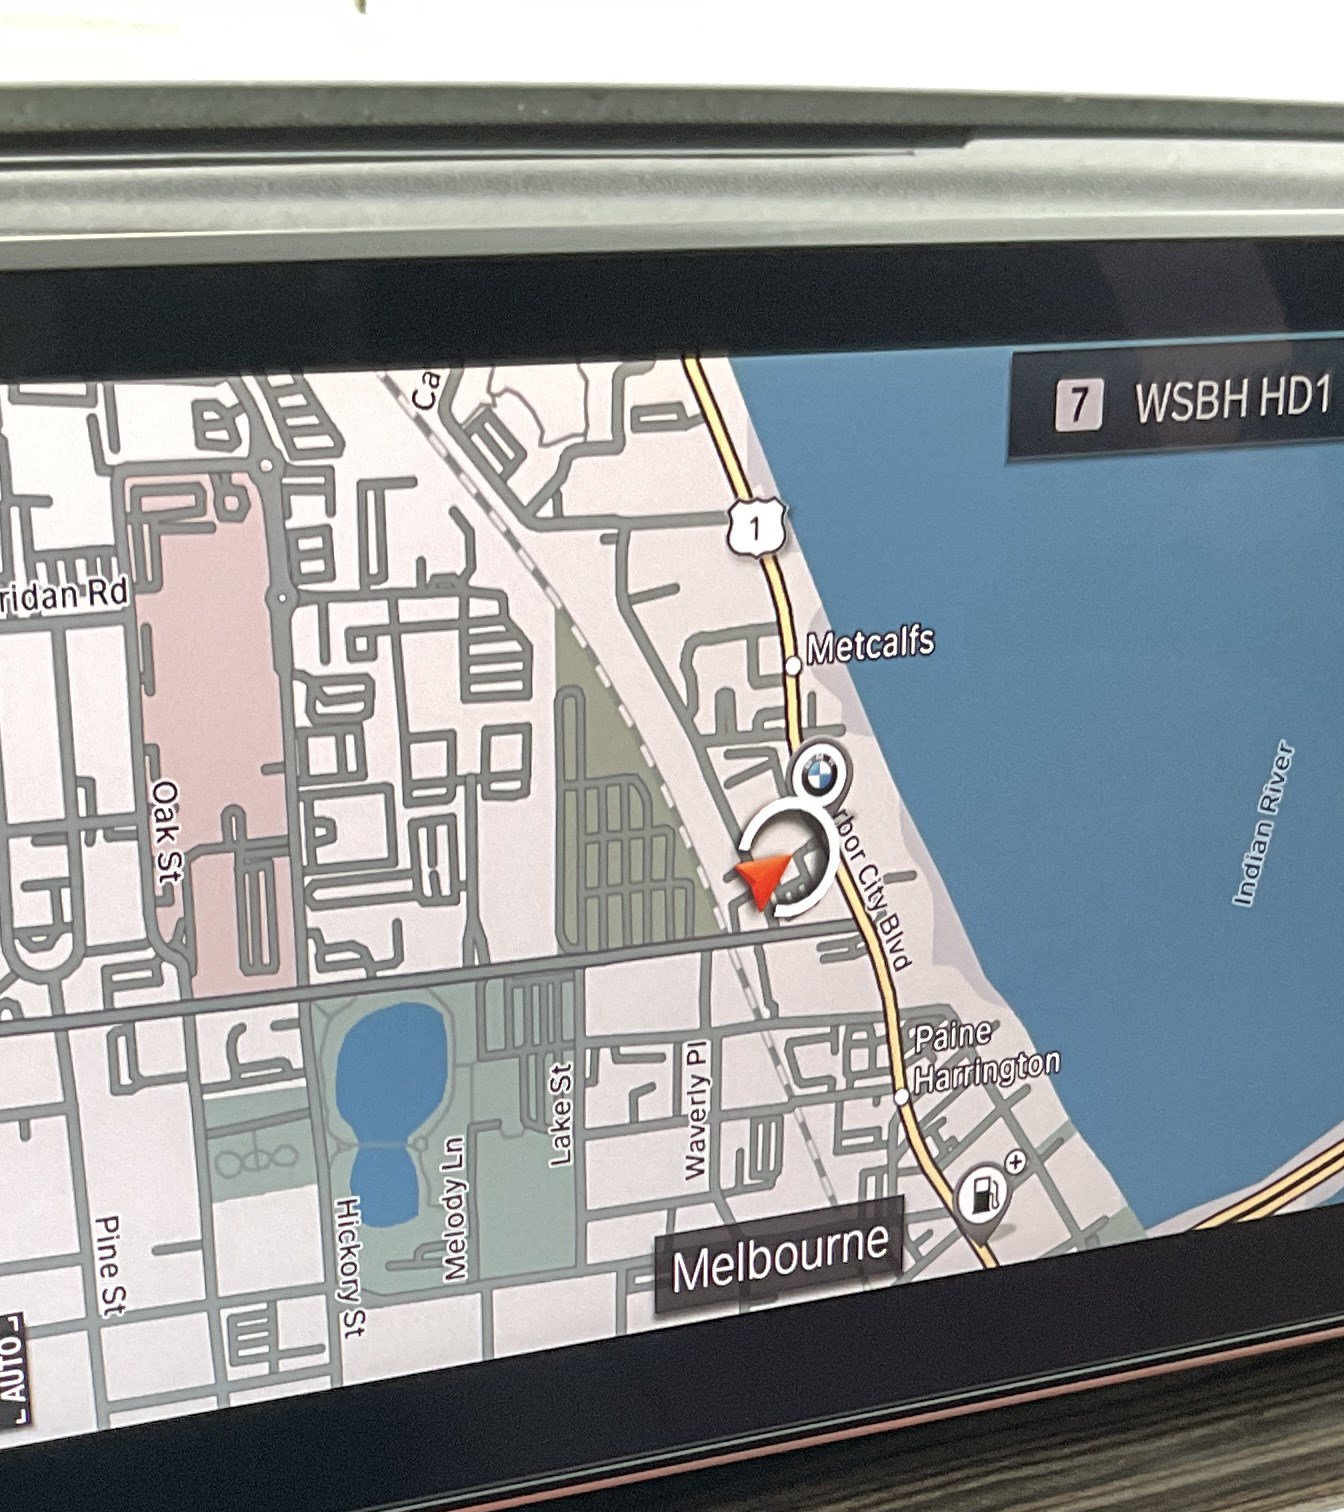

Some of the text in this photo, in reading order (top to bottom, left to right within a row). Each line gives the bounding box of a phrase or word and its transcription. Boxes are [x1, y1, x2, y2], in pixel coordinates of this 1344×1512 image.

[1070, 385, 1090, 424] 7
[1134, 372, 1332, 425] WSBH HD1
[87, 576, 129, 607] Rd
[806, 623, 936, 666] Metcalfs
[152, 781, 183, 884] Oak St
[1232, 740, 1295, 906] Indian River
[832, 808, 913, 973] rbor City Blvd
[913, 1051, 1061, 1095] Harrington
[914, 1020, 993, 1054] Paine
[550, 1063, 572, 1166] Lake St
[684, 1041, 712, 1181] Waverly Pl
[441, 1137, 468, 1281] Melody Ln
[672, 1225, 890, 1294] Melbourne
[95, 1215, 127, 1317] Pine St
[336, 1198, 366, 1340] Hickory St
